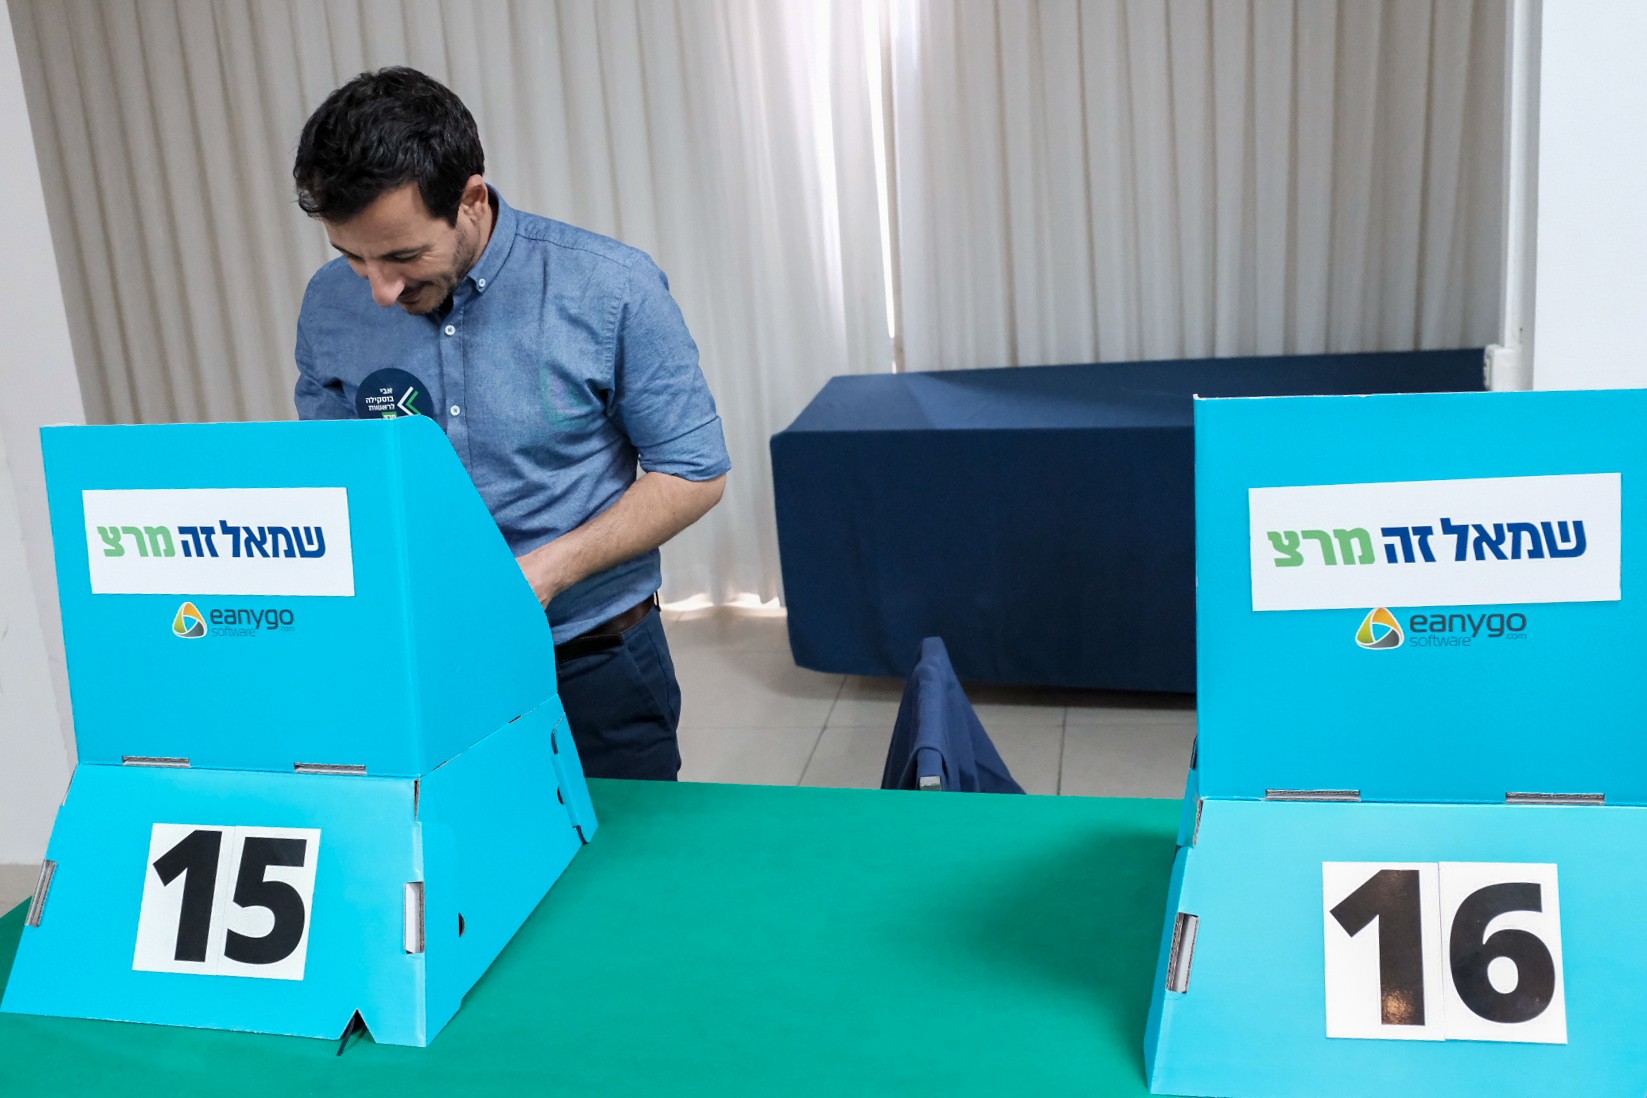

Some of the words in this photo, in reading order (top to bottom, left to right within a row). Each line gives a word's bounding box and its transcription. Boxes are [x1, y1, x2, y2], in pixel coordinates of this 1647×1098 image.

[365, 396, 394, 404] בוסקילה
[368, 403, 395, 411] לראשות
[97, 525, 176, 557] מרצ
[177, 525, 219, 558] זה
[219, 519, 326, 558] שמאל
[1267, 527, 1376, 567] מרצ
[1380, 525, 1437, 564] זה
[1439, 517, 1588, 562] שמאל
[210, 608, 295, 630] eanygo
[211, 626, 256, 637] software
[1409, 612, 1527, 638] eanygo
[1409, 634, 1471, 647] software
[152, 829, 306, 965] 15
[1329, 869, 1556, 1026] 16
